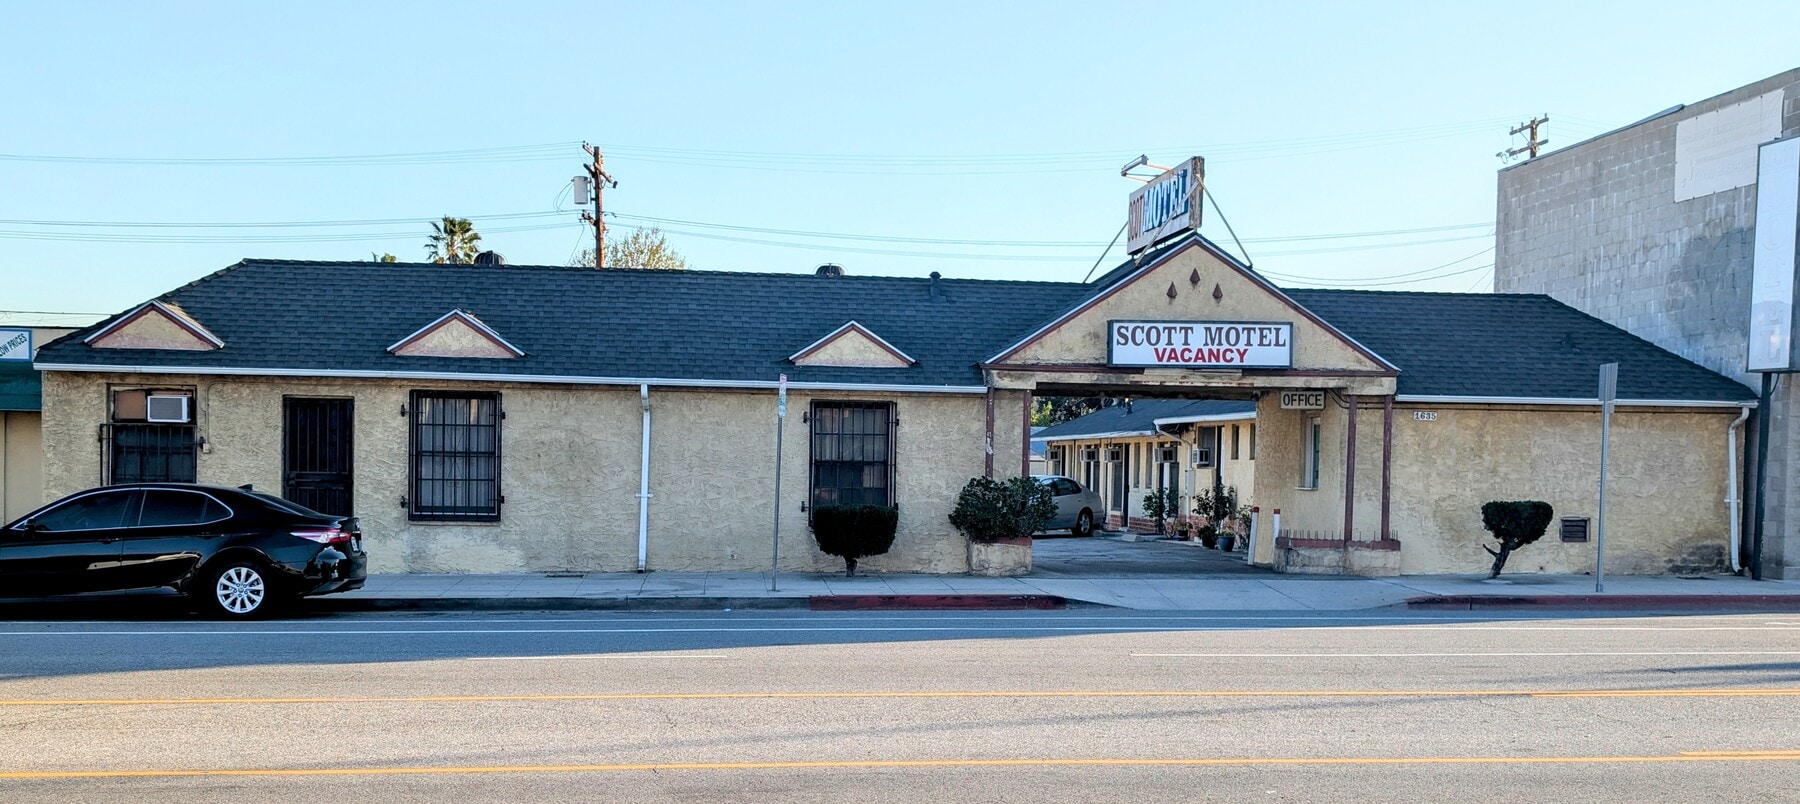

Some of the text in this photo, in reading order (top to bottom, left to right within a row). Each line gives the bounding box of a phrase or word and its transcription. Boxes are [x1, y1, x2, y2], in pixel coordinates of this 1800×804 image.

[1143, 169, 1189, 233] MOTEL
[7, 333, 27, 350] PRICES
[1116, 325, 1286, 347] SCOTT MOTEL
[1153, 347, 1249, 363] VACANCY
[1282, 393, 1322, 407] OFFICE
[1414, 412, 1436, 420] 1635
